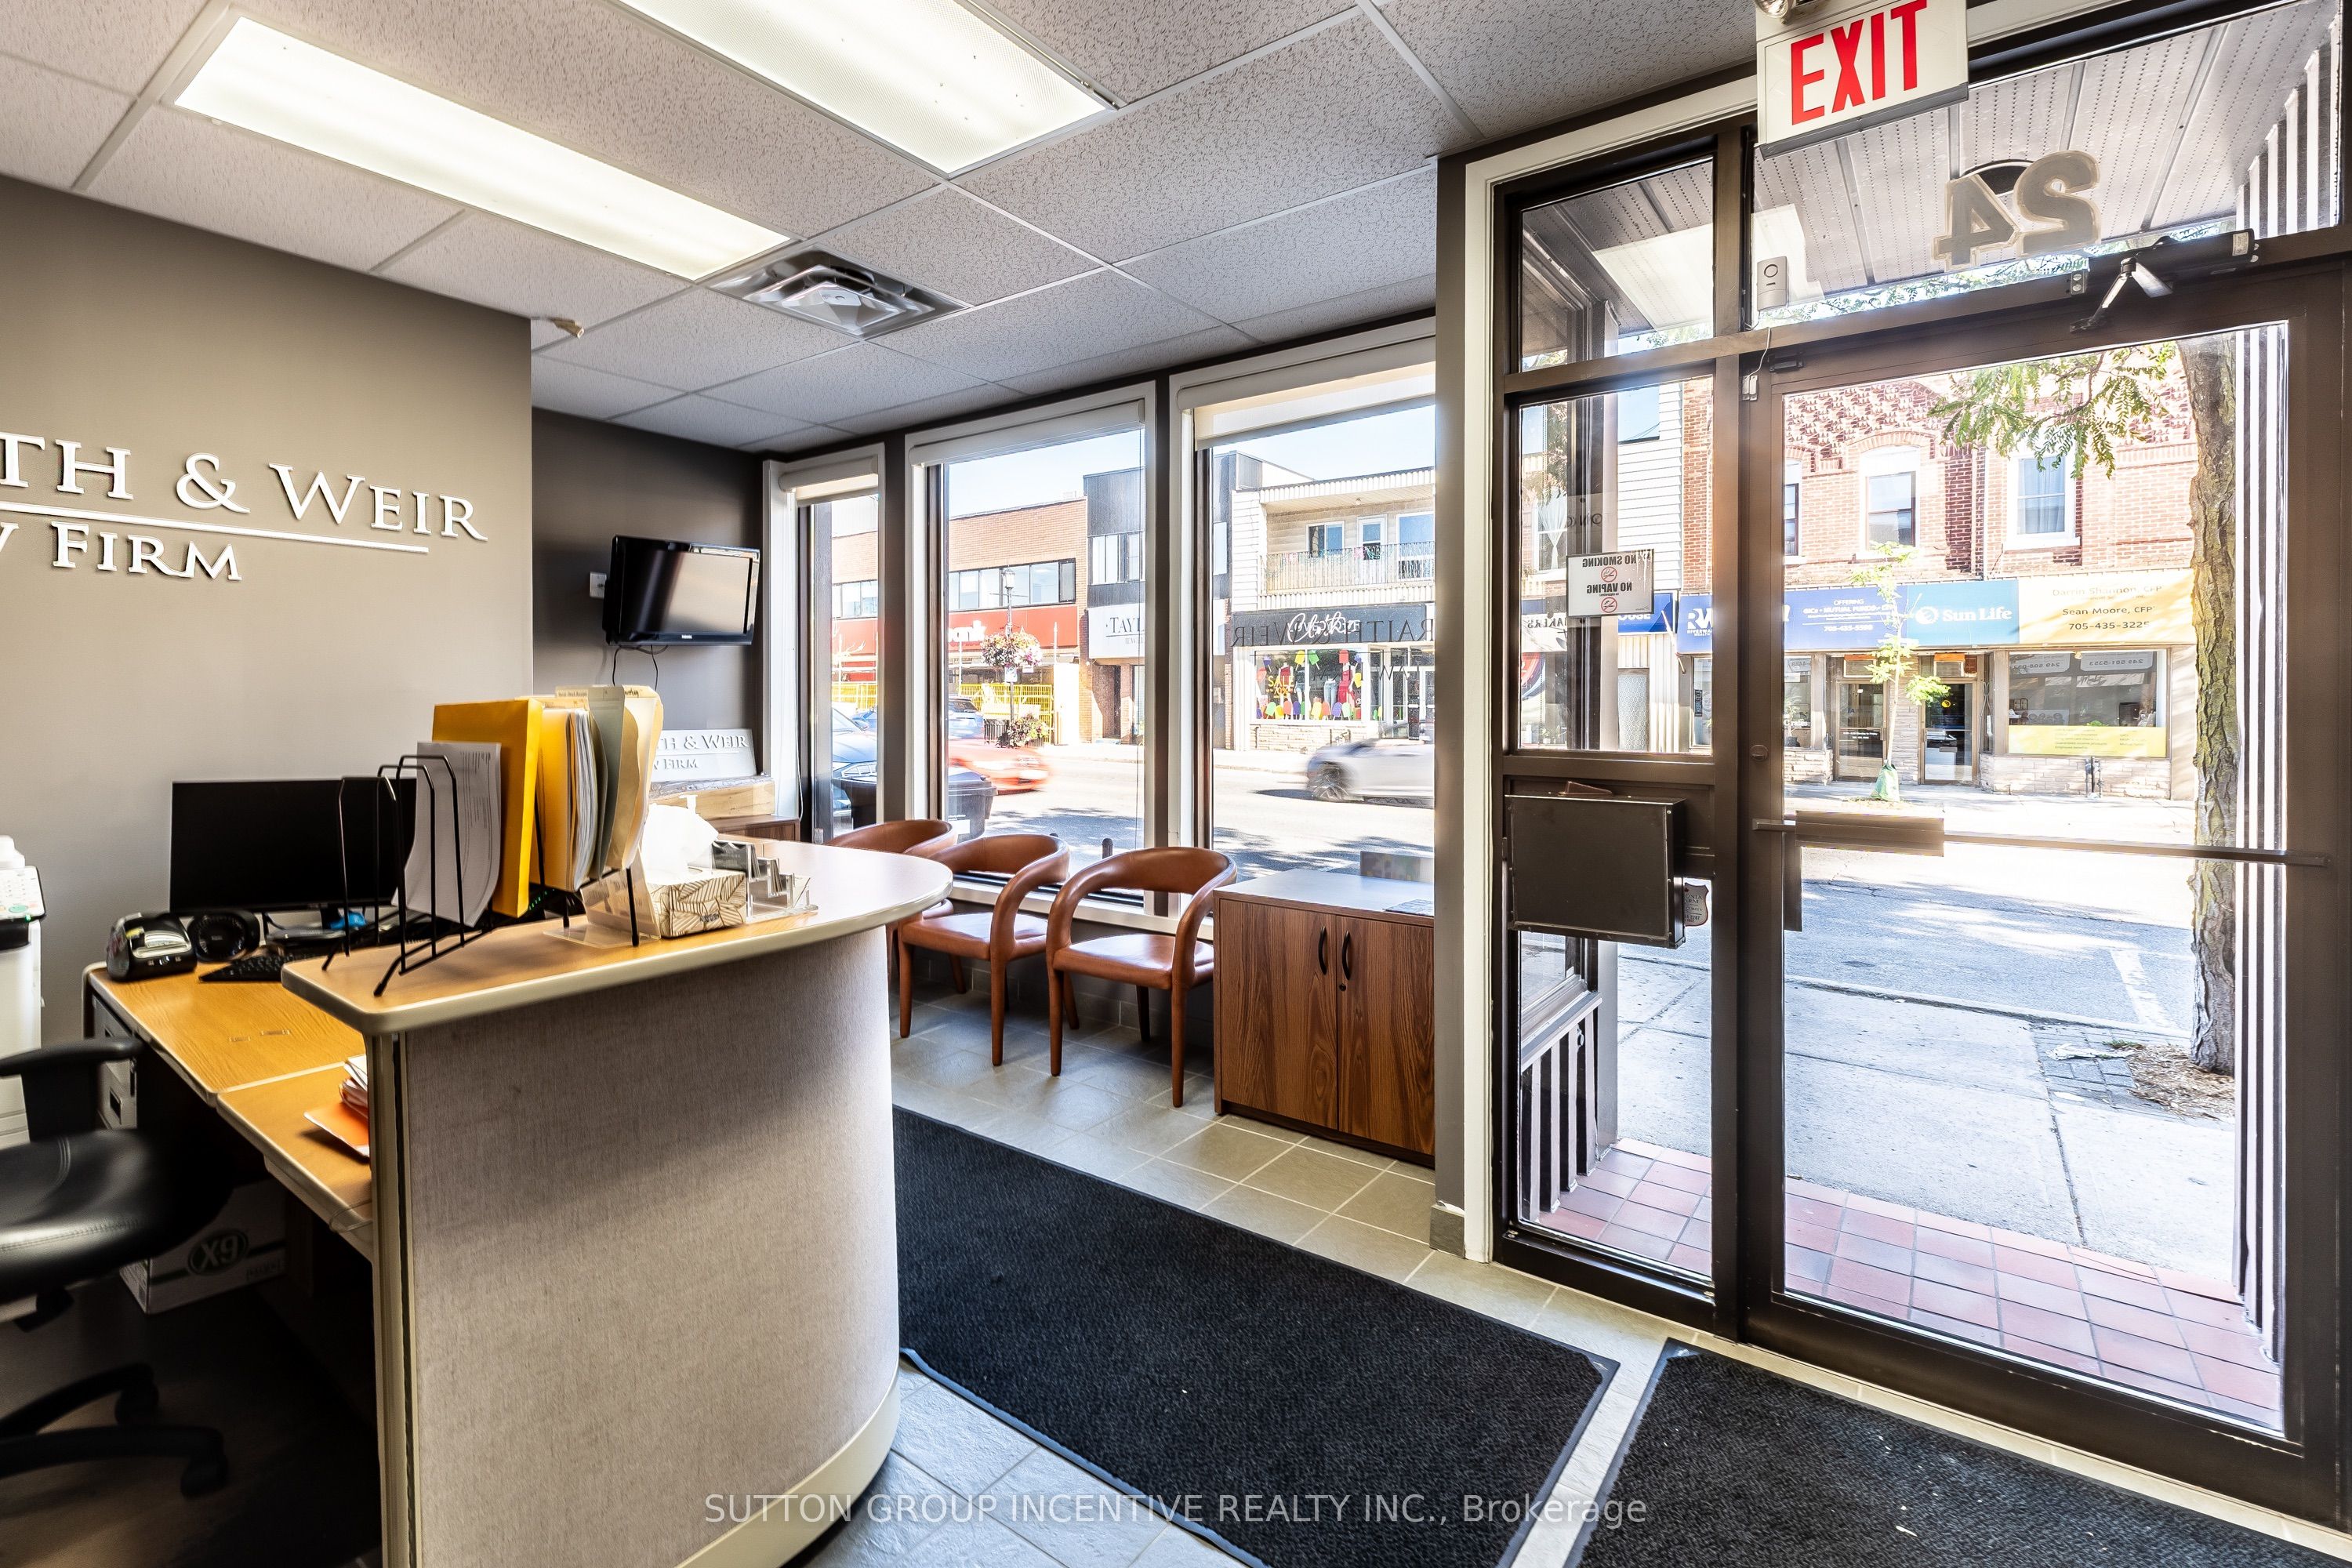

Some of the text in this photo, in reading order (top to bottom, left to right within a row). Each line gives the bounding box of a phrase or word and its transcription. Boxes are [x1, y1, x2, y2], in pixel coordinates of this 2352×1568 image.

[1791, 0, 1927, 125] EXIT
[176, 452, 250, 514] &
[51, 521, 242, 581] FIRM
[1942, 606, 2011, 622] Sun Life
[2092, 607, 2130, 615] Moore,
[1268, 675, 1294, 688] SALE
[198, 1235, 239, 1272] X9
